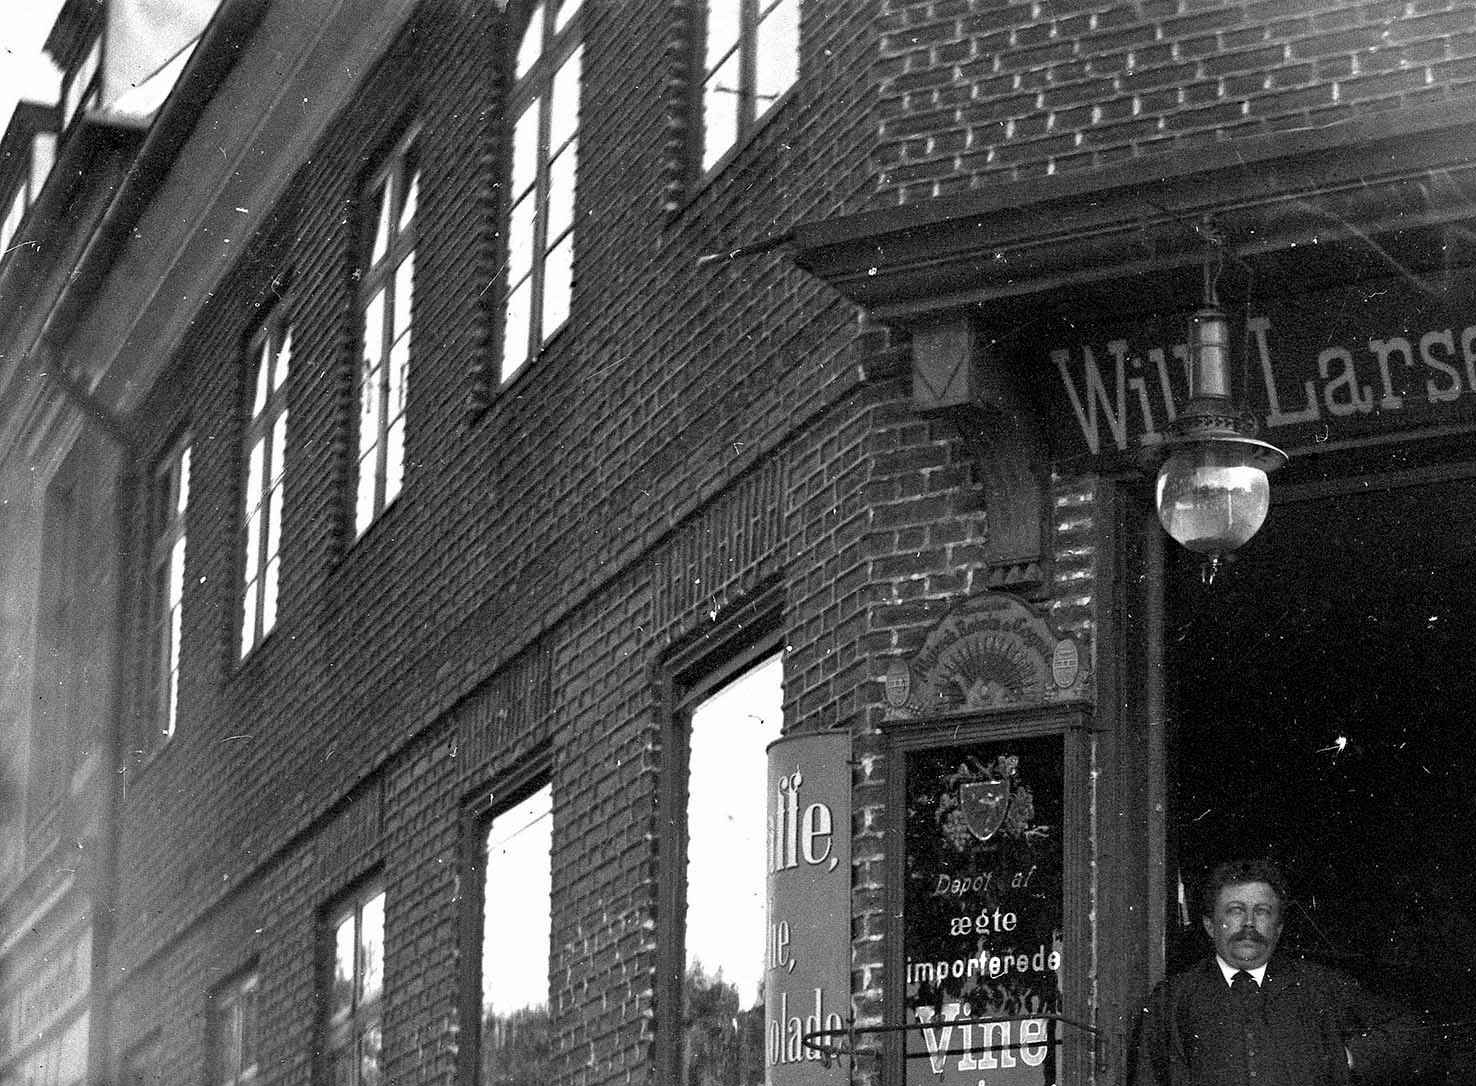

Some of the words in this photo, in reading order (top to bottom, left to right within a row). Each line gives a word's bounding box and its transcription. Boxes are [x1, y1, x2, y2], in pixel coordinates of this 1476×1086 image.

[1049, 339, 1190, 455] Wil
[767, 773, 839, 873] ffe,
[950, 907, 1017, 936] ægte
[906, 945, 1061, 987] importerede
[916, 1002, 1049, 1074] Vine
